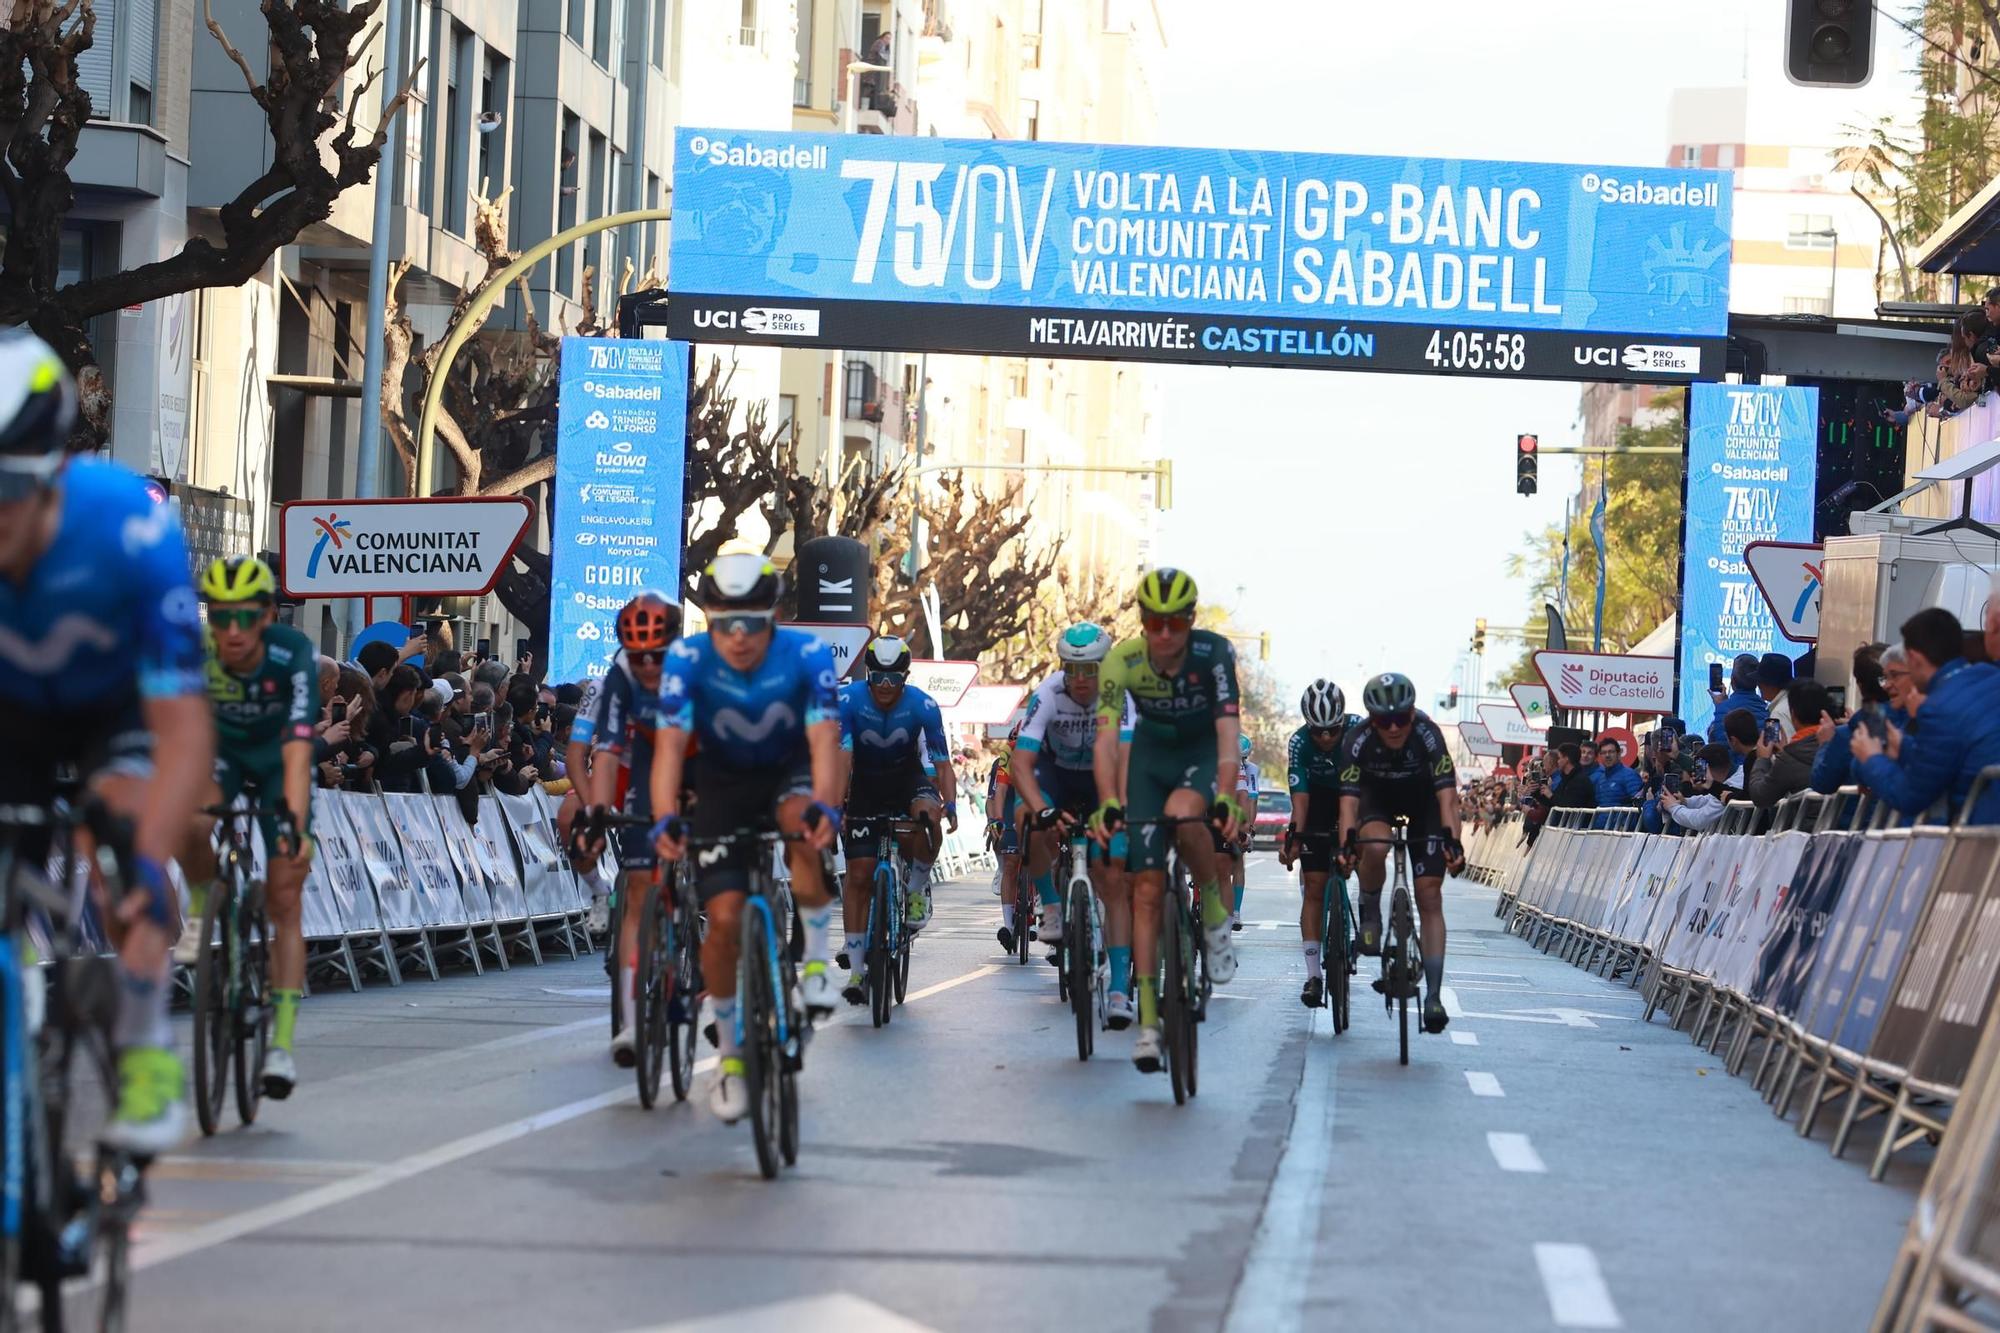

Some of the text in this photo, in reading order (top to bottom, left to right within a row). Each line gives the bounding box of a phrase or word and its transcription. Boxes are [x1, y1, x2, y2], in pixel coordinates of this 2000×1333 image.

[709, 141, 828, 169] Sabadell
[1073, 170, 1273, 217] VOLTA A LA
[1600, 178, 1719, 208] Sabadell
[1071, 216, 1271, 261] COMUNITAT
[1071, 259, 1267, 302] VALENCIANA
[1292, 248, 1562, 314] SABADELL
[693, 309, 792, 329] UCI PRO
[772, 321, 805, 331] SERIES
[1029, 317, 1526, 371] META/ARRIVÉE: CASTELLÓN 4:05:58
[1574, 346, 1674, 366] UCI PRO
[1652, 359, 1686, 370] SERIES
[594, 383, 661, 401] Sabadell
[612, 416, 656, 425] TRINIDAD
[612, 425, 656, 433] ALFONSO
[1726, 424, 1781, 438] VOLTA A LA
[1725, 437, 1781, 450] COMUNITAT
[596, 452, 647, 468] tuawa
[1725, 449, 1780, 461] VALENCIANA
[1722, 464, 1788, 482] Sabadell
[1722, 520, 1777, 533] VOLTA A LA
[356, 532, 481, 550] COMUNITAT
[600, 534, 657, 547] HYUNDAI
[608, 547, 649, 557] Koryo Car
[1722, 544, 1747, 555] VALE
[328, 553, 483, 574] VALENCIANA
[585, 565, 644, 586] GOBIK
[586, 594, 633, 610] Saba
[1718, 614, 1774, 629] VOLTA A LA
[1718, 628, 1773, 641] COMUNITAT
[1717, 640, 1773, 652] VALENCIANA
[1589, 668, 1658, 685] Diputació
[1589, 683, 1665, 699] de Castelló
